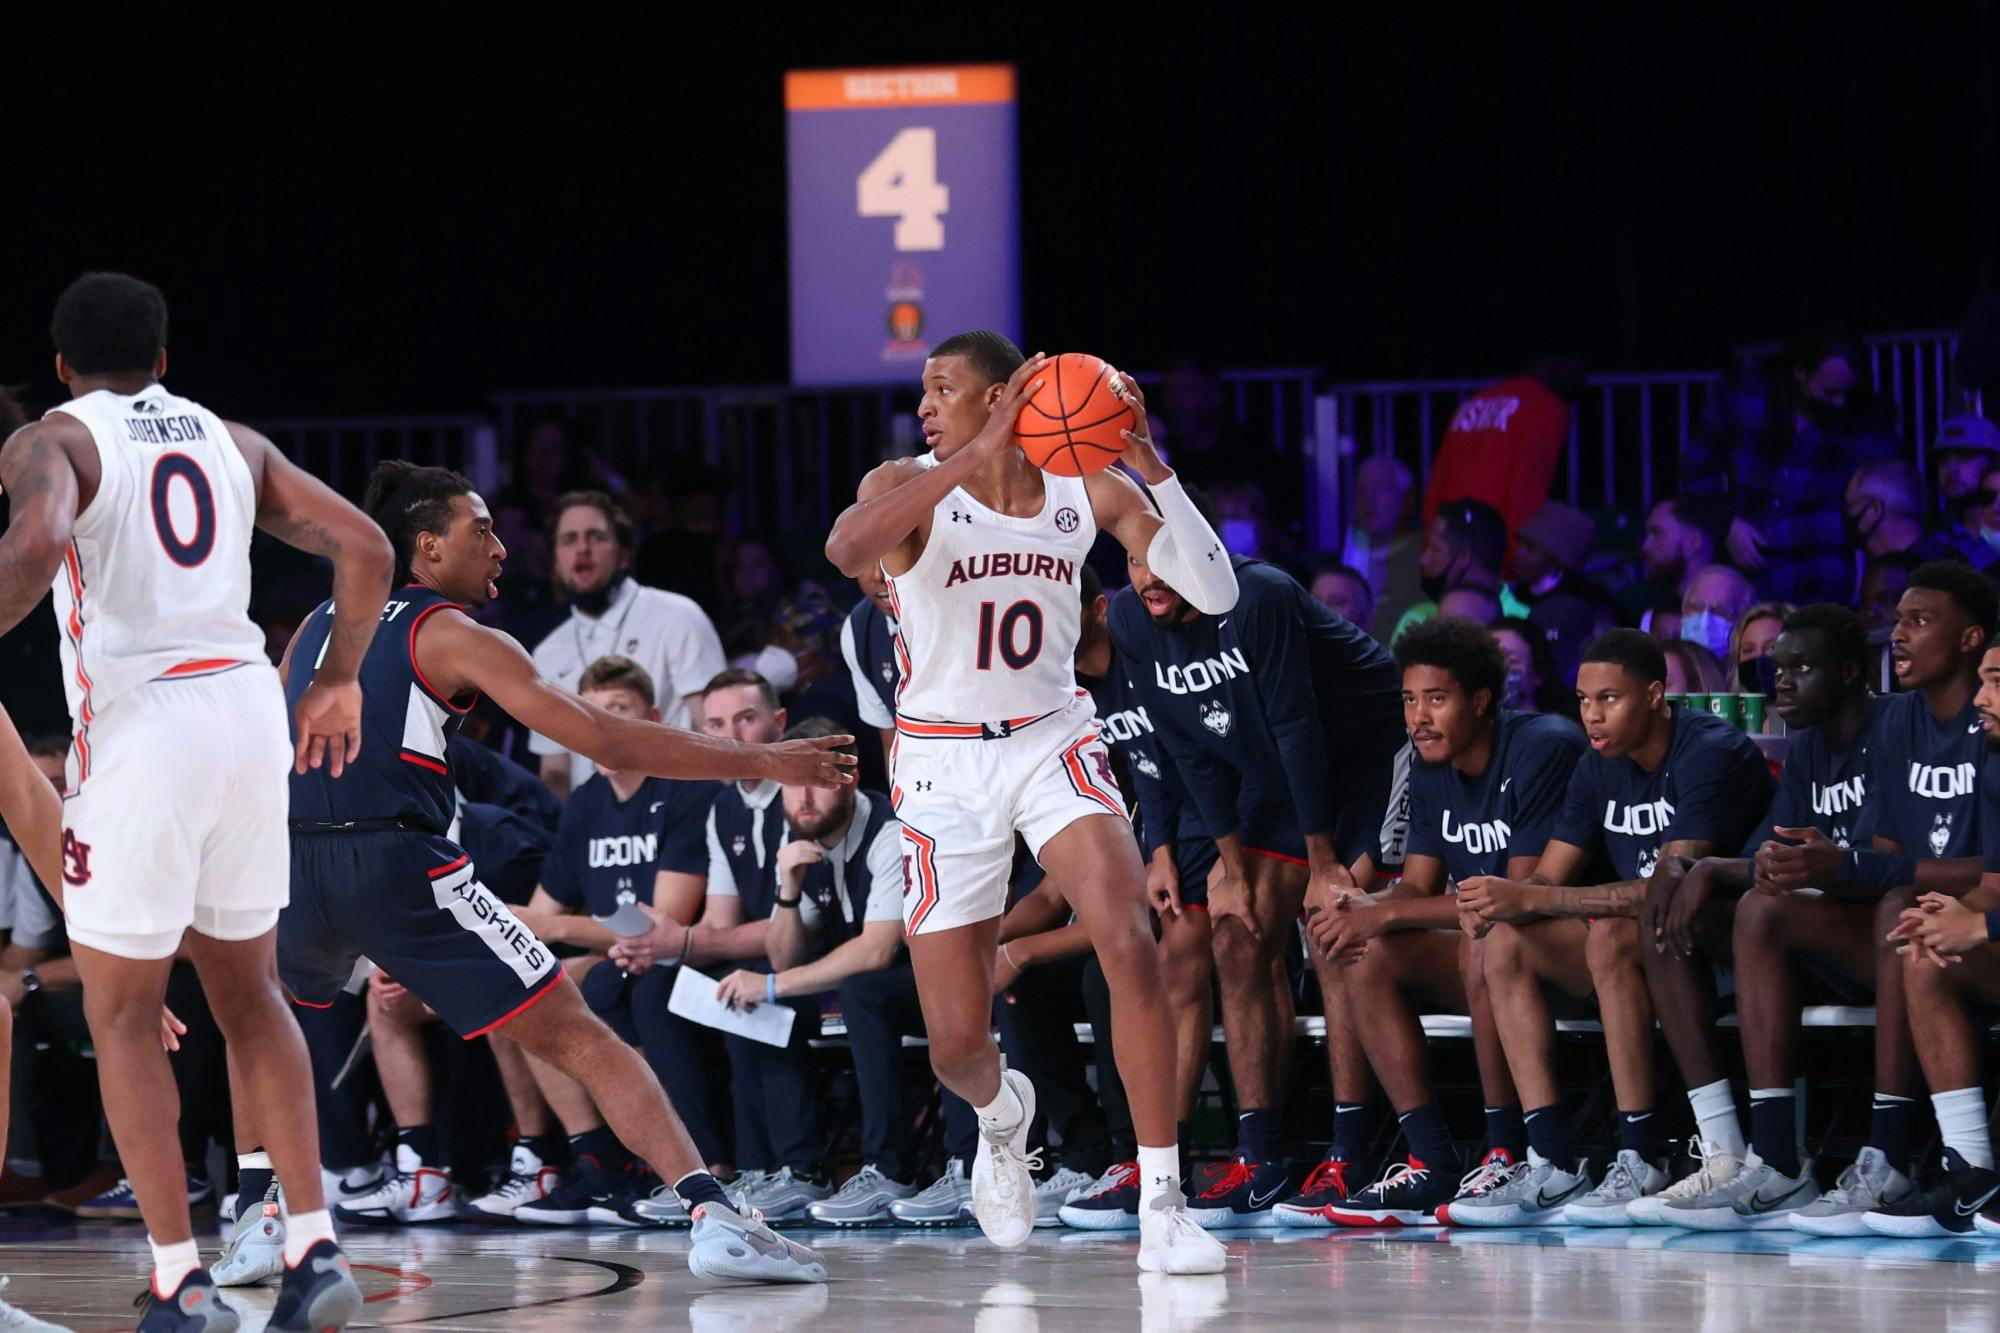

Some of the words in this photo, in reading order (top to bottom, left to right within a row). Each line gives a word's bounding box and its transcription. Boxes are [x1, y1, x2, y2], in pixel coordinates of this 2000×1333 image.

[857, 126, 949, 251] 4
[124, 415, 208, 444] JOHNSON
[151, 451, 216, 569] 0
[945, 552, 1074, 588] AUBURN
[976, 599, 1043, 671] 10
